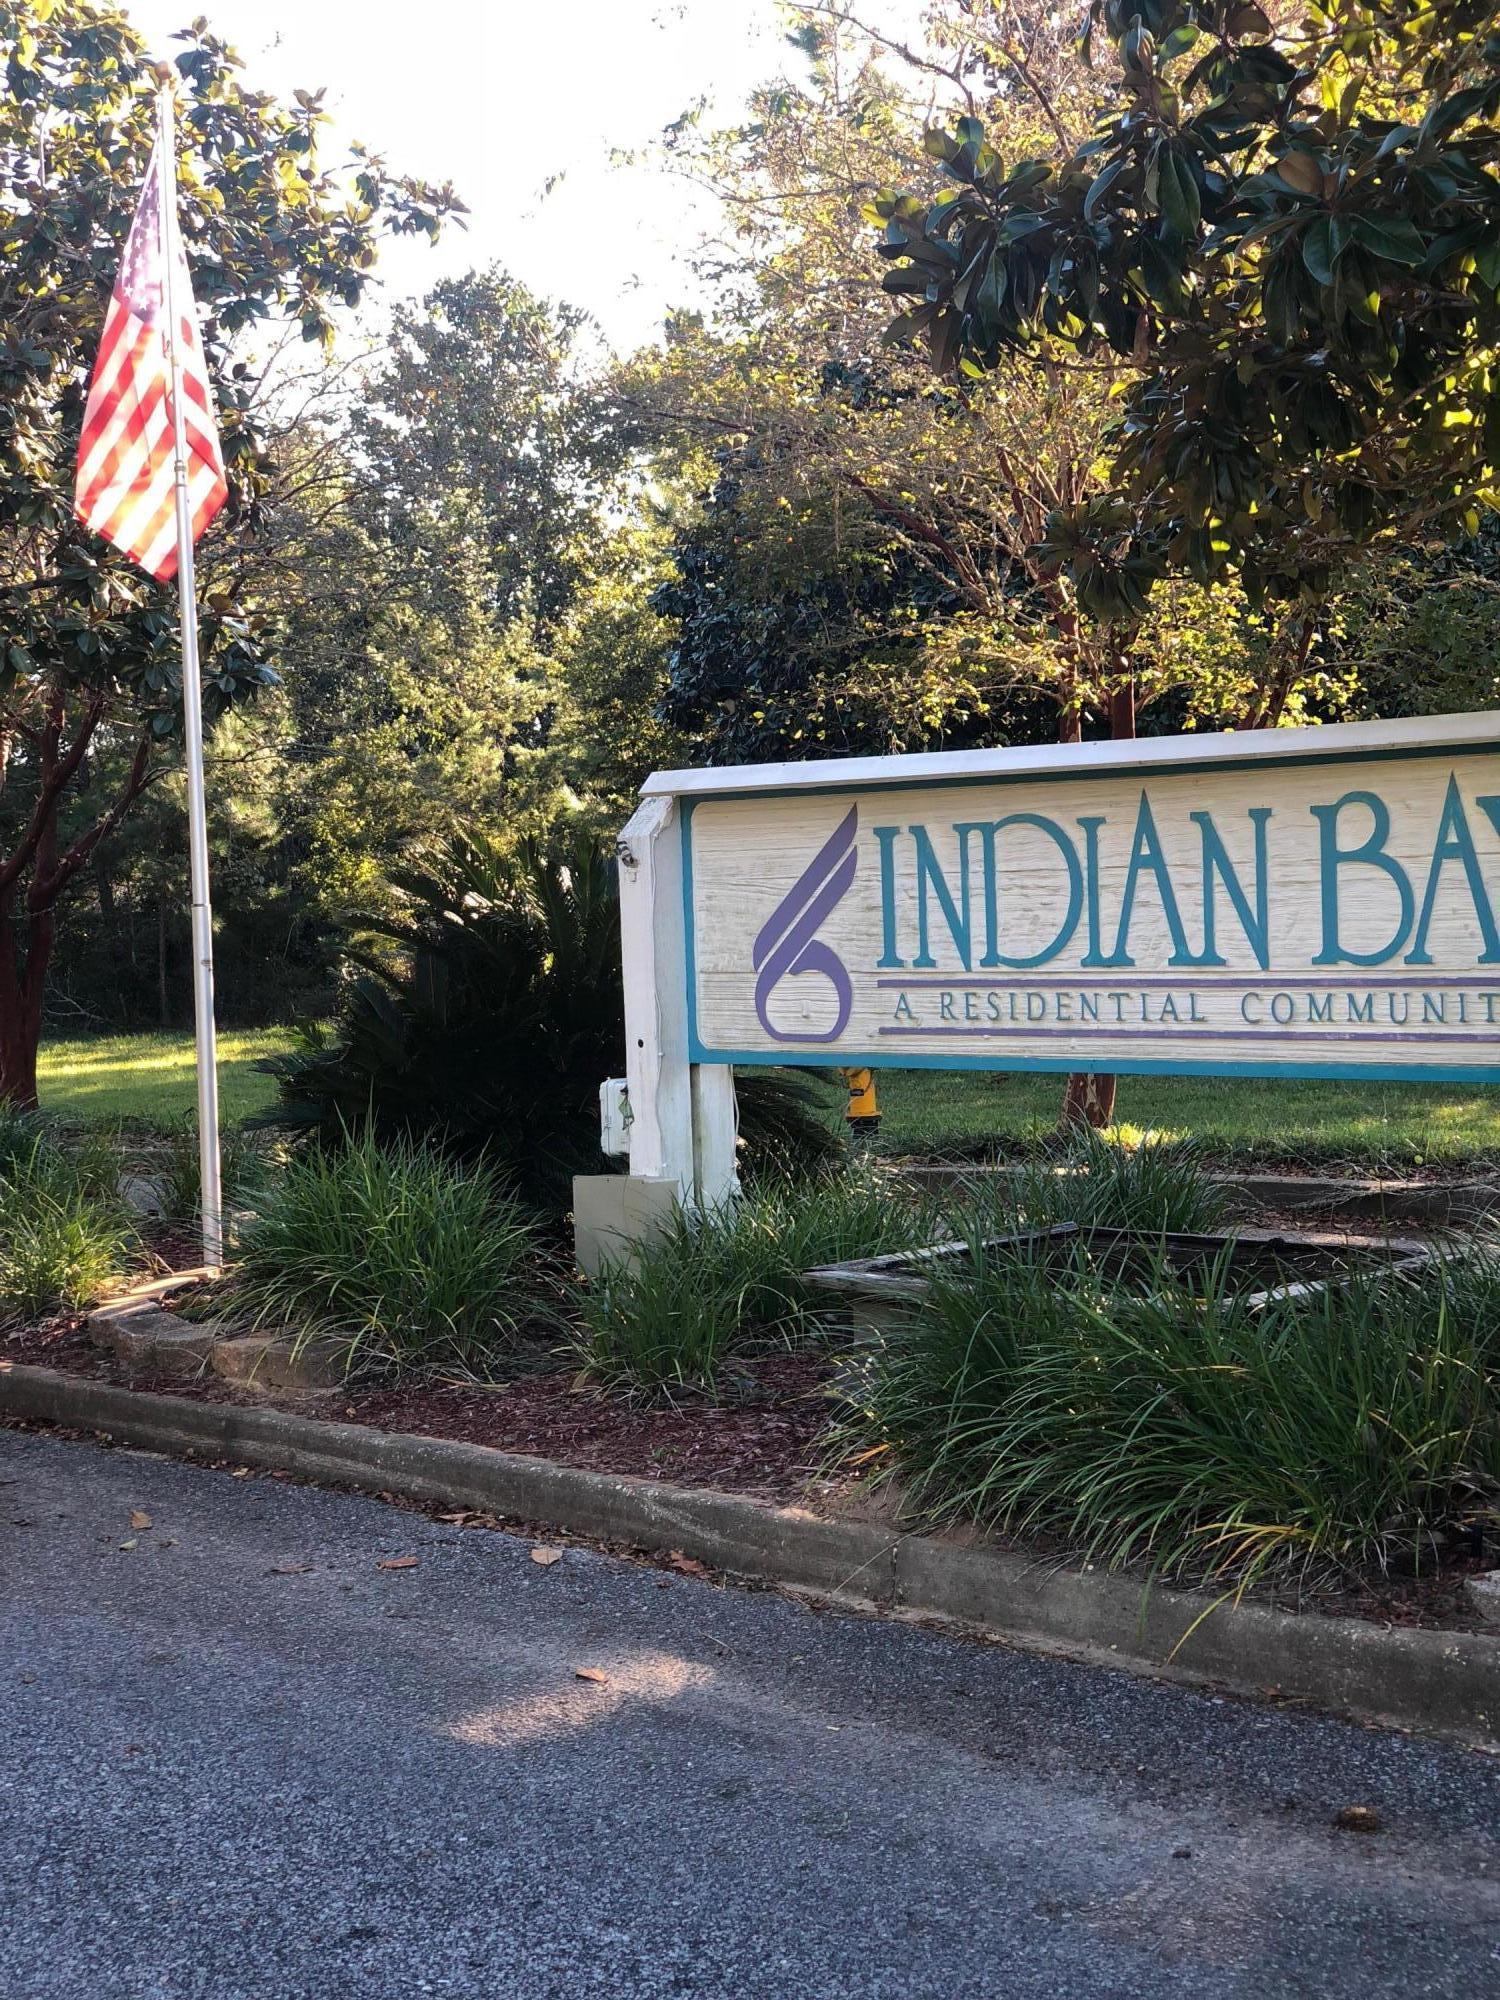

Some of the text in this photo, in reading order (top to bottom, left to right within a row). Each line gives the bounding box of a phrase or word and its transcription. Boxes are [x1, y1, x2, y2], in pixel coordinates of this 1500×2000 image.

[872, 769, 1500, 973] INDIAN BA
[894, 991, 1500, 1026] A RESIDENTIAL COMMUNIT
